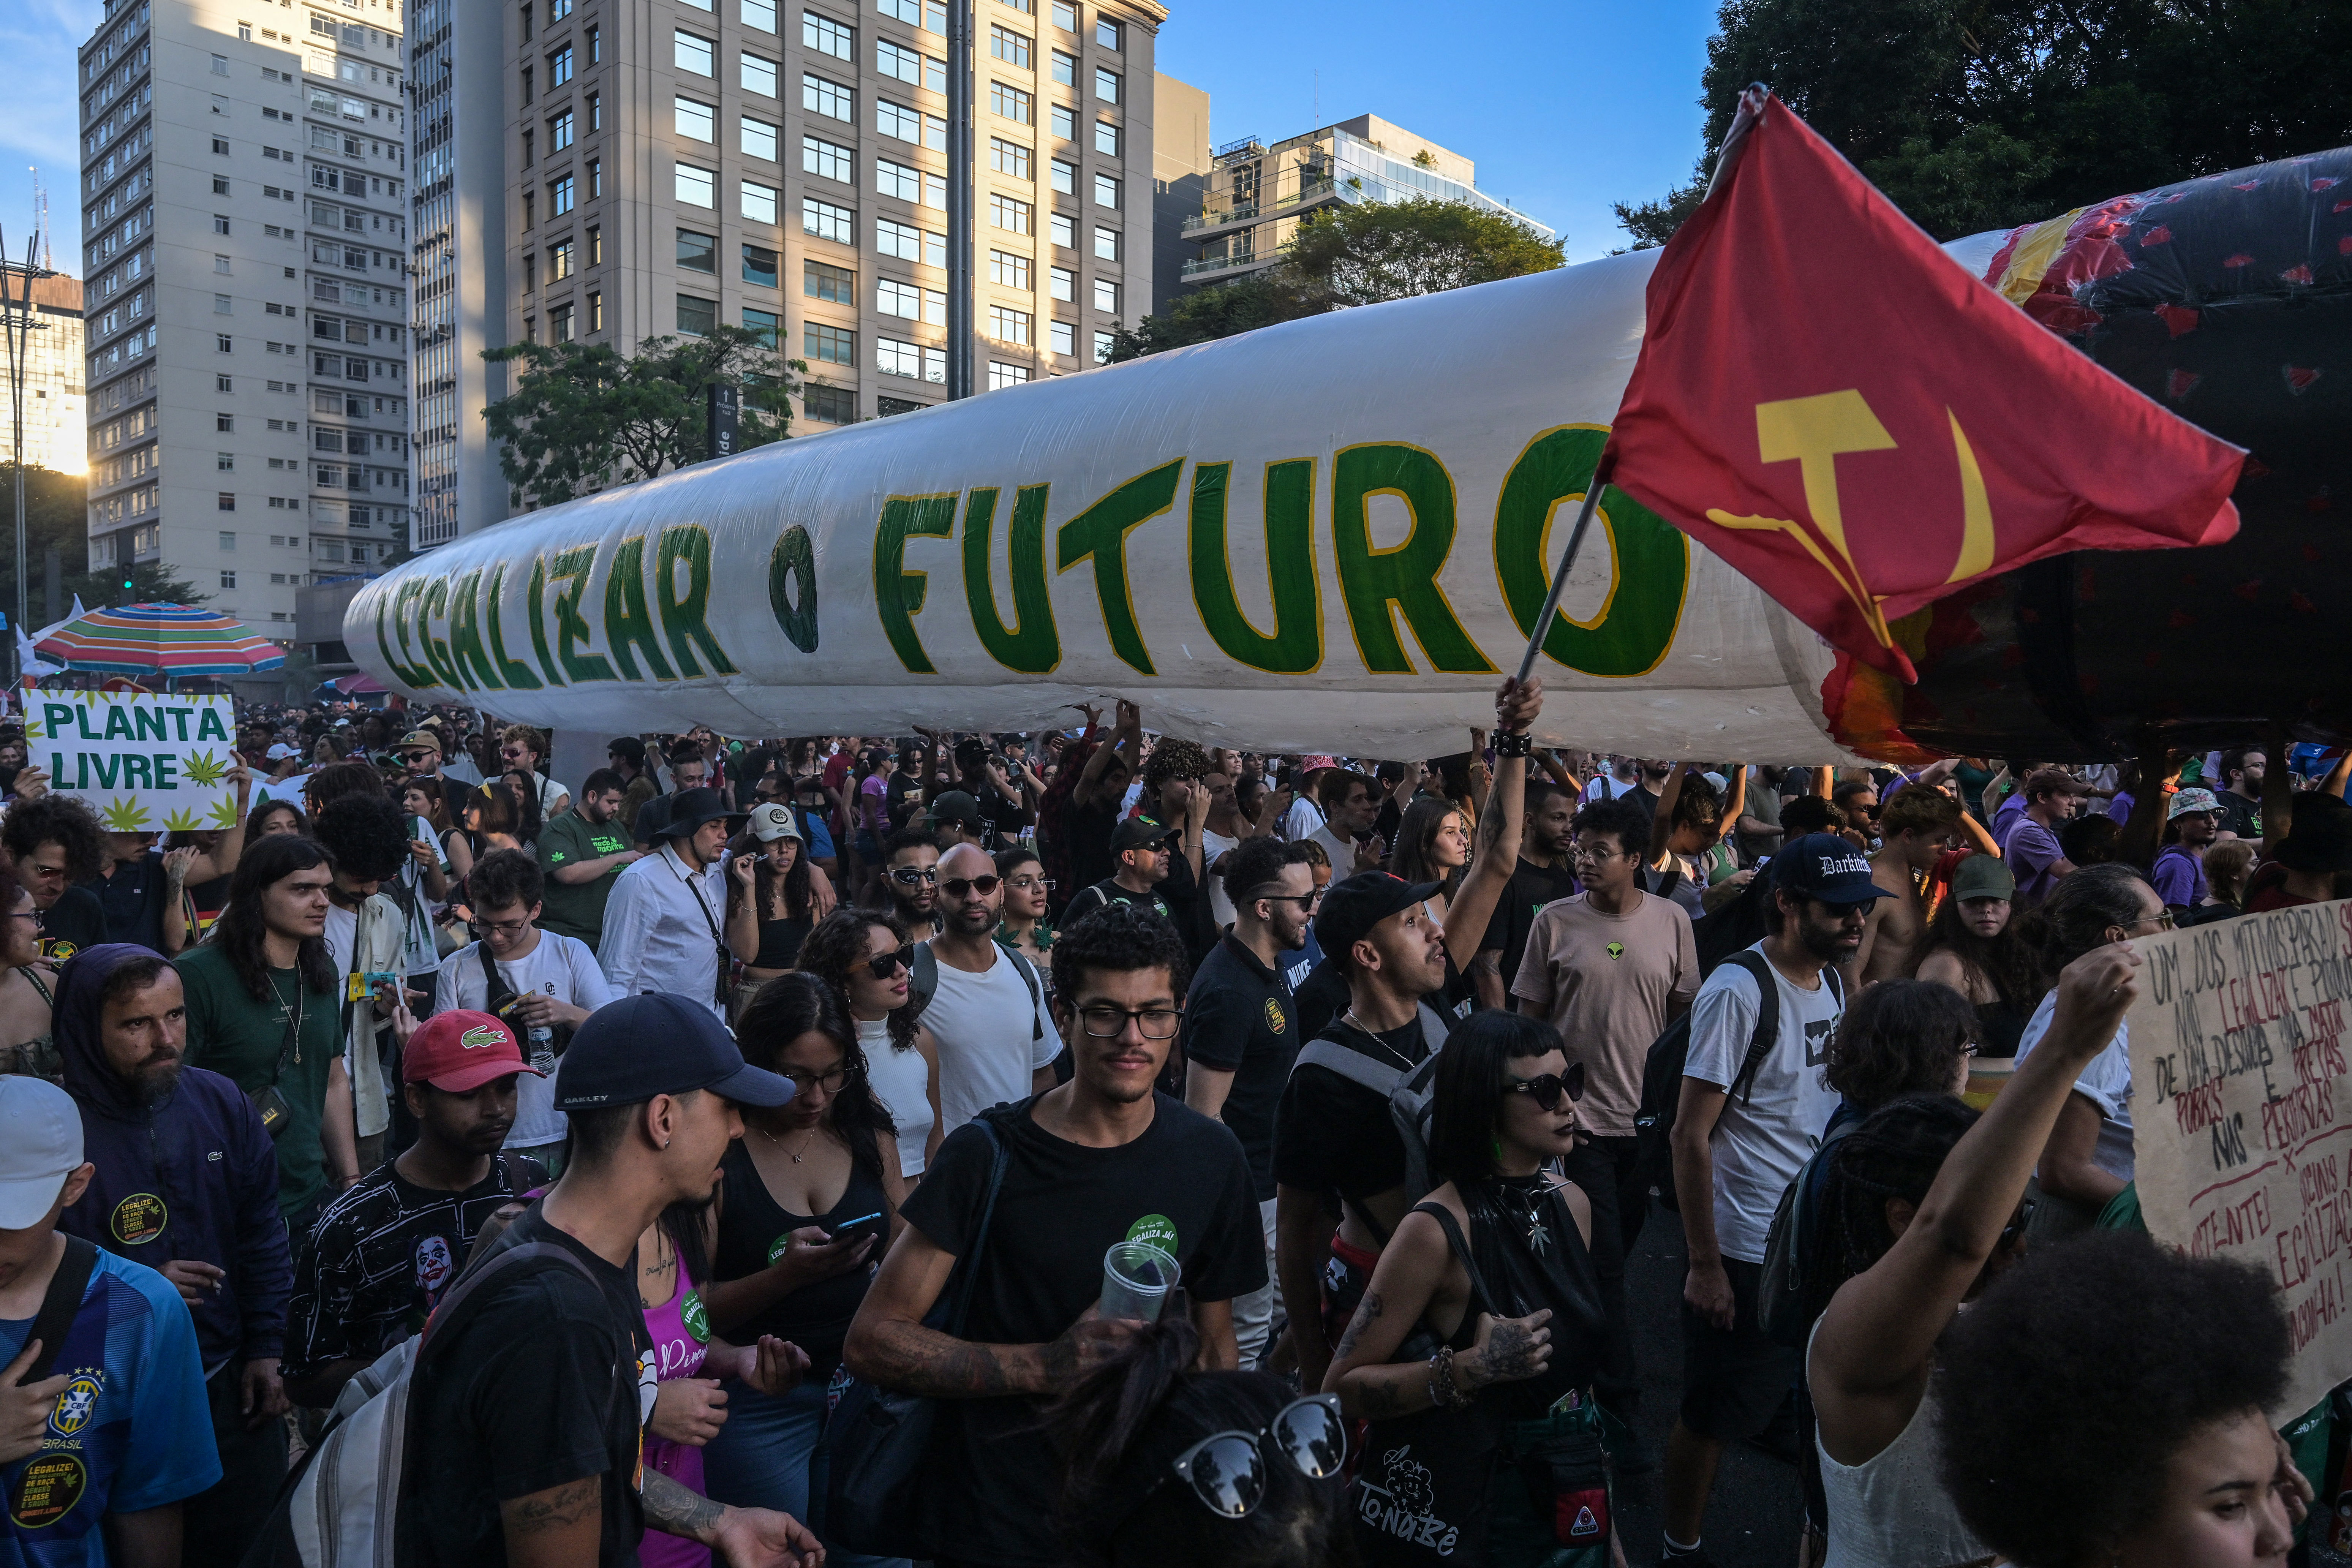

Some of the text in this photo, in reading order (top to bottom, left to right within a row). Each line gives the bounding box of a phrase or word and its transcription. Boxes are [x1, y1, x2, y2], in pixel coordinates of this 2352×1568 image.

[716, 401, 736, 411] Próxima
[719, 431, 730, 456] ide
[376, 422, 1690, 692] LEGALIZAR O FUTURO
[43, 703, 228, 741] PLANTA
[51, 752, 177, 790] LIVRE
[1287, 958, 1312, 989] NIKE
[2148, 942, 2182, 1005] UM
[2194, 929, 2225, 994] DOS
[30, 974, 43, 989] COLORIDO
[1272, 1017, 1282, 1027] LIVRE
[2155, 1052, 2178, 1104] DE
[2262, 1064, 2281, 1103] E
[2212, 1112, 2247, 1171] NAS
[795, 1154, 801, 1163] N
[122, 1198, 153, 1211] LEGALIZE!
[124, 1220, 143, 1228] CLASSE
[1129, 1230, 1174, 1242] EGALIZA JÁ!
[684, 1302, 700, 1323] LEGALIZA
[2289, 1262, 2346, 1358] ACONHA!
[42, 1439, 83, 1449] BRASIL
[29, 1463, 74, 1475] LEGALIZE!
[23, 1493, 50, 1502] CLASSE
